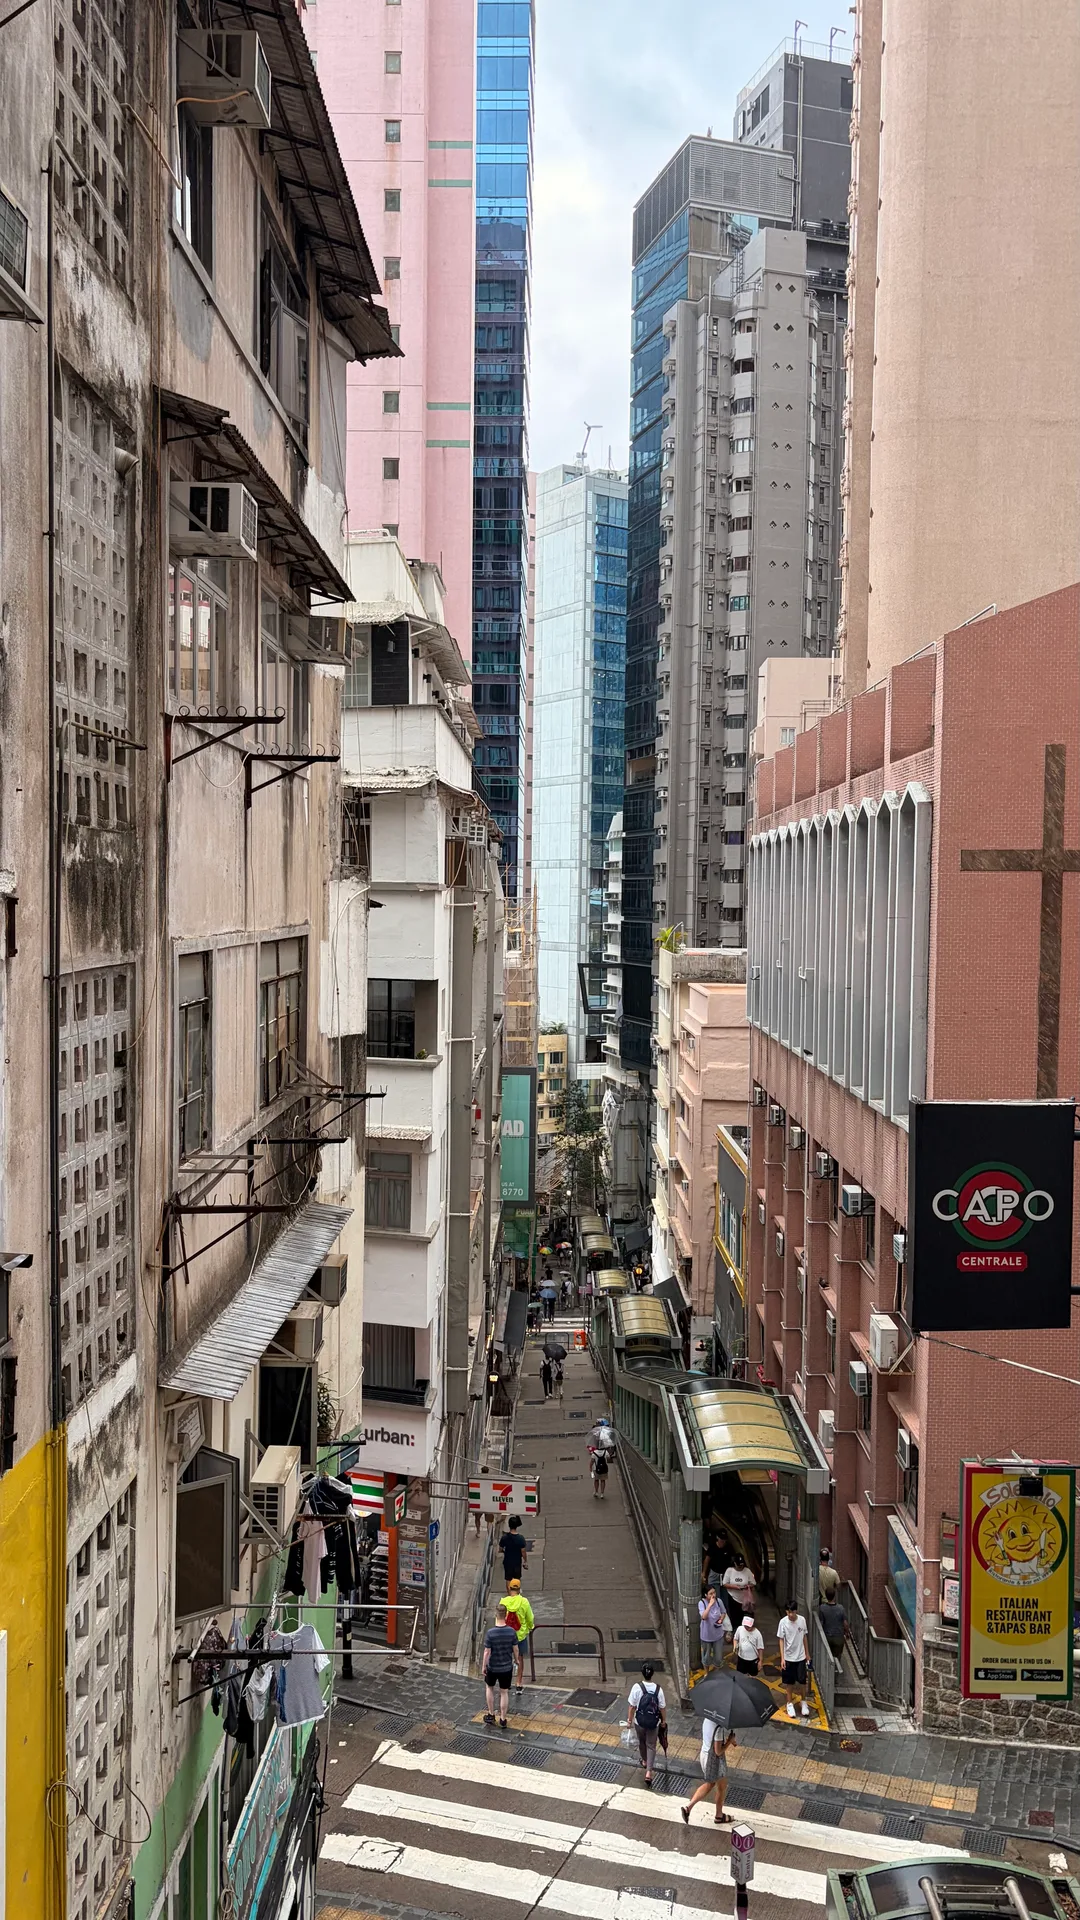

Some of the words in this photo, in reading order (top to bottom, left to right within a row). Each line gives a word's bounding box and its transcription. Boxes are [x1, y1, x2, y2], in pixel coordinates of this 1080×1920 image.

[502, 1188, 523, 1196] 8770
[932, 1189, 1054, 1222] CAPO
[962, 1256, 1022, 1266] CENTRALE
[365, 1427, 415, 1447] urban:
[492, 1483, 513, 1511] 7
[1000, 1597, 1039, 1609] ITALIAN
[986, 1610, 1052, 1622] RESTAURANT
[987, 1622, 1026, 1634] &TAPAS
[1029, 1623, 1051, 1634] BAR
